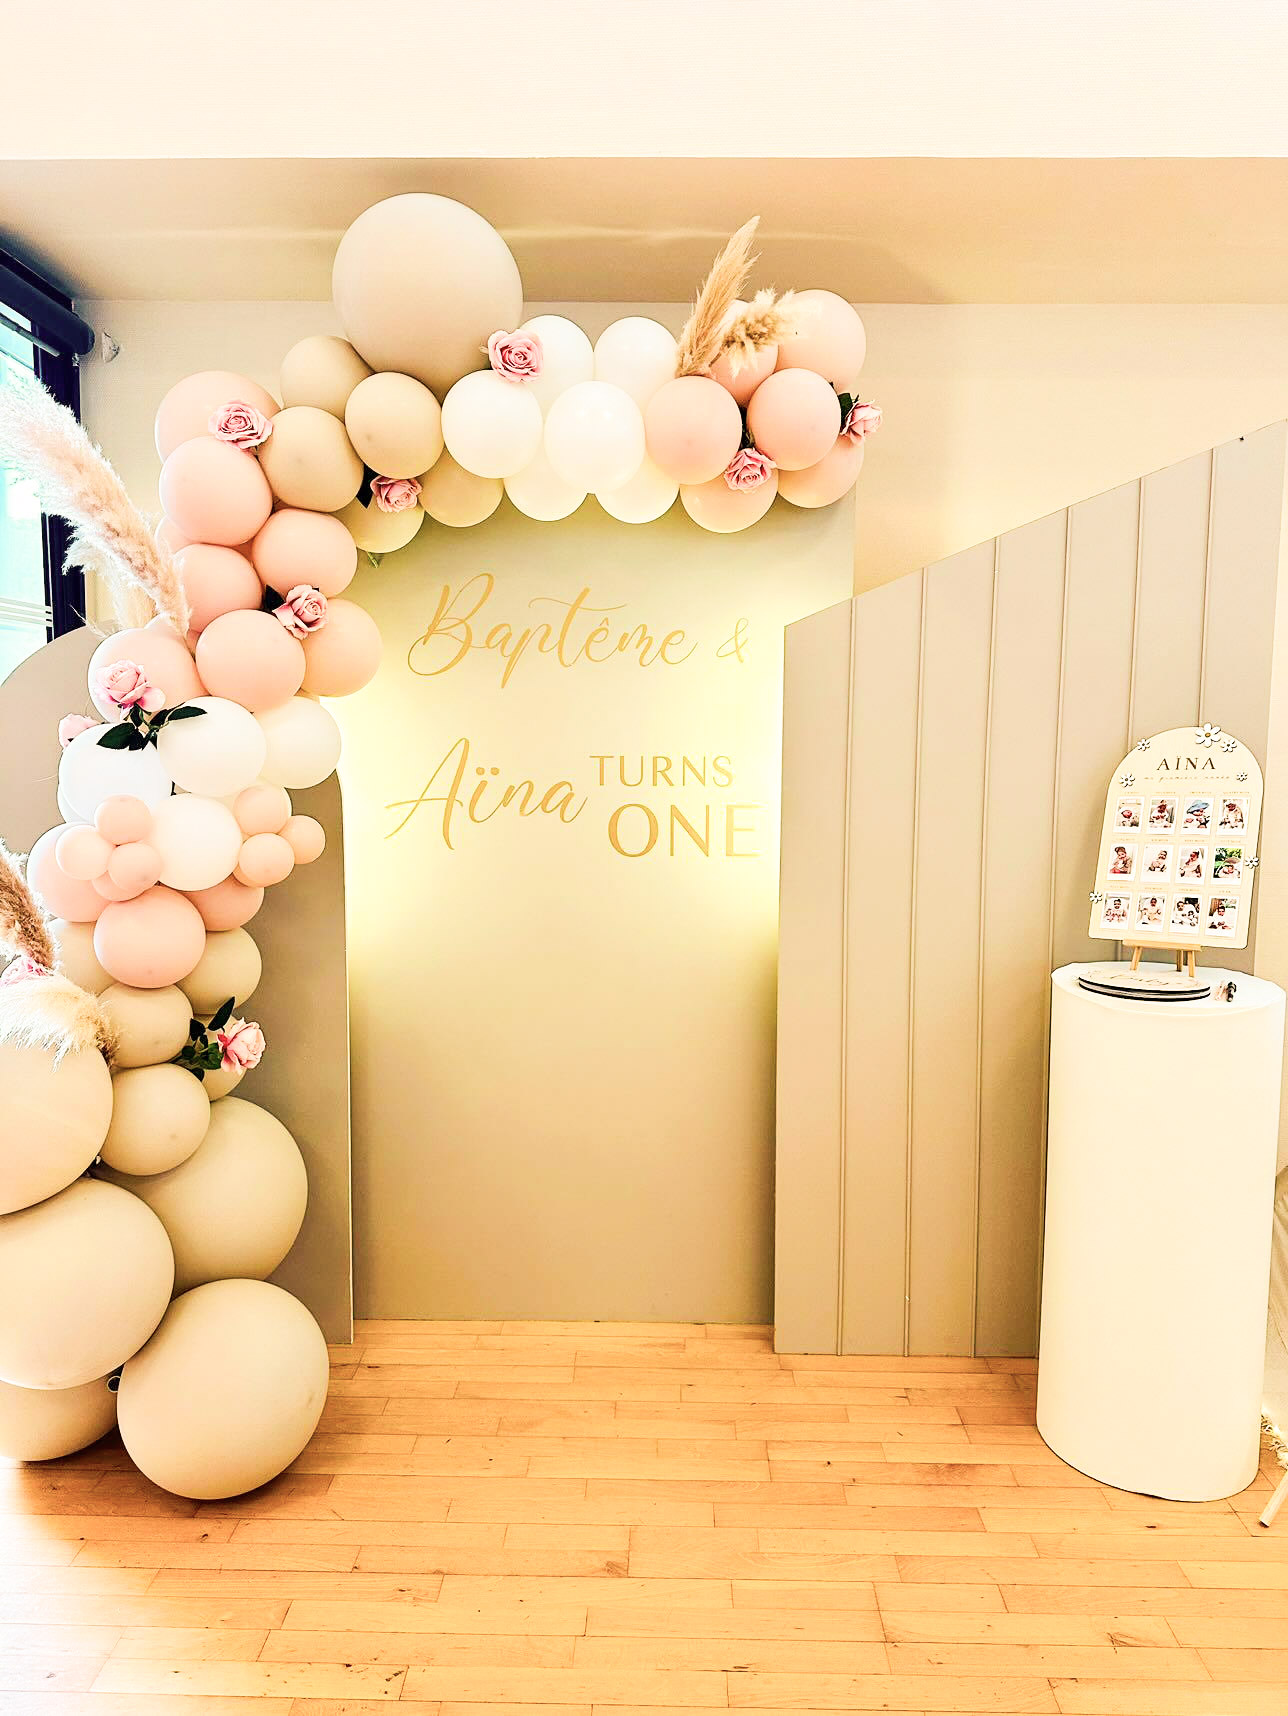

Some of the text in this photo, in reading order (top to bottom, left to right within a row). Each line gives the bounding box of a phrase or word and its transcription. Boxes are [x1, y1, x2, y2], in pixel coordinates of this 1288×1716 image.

[407, 572, 750, 689] Baptême &
[384, 737, 588, 851] Aïna
[589, 754, 734, 788] TURNS
[607, 803, 761, 858] ONE
